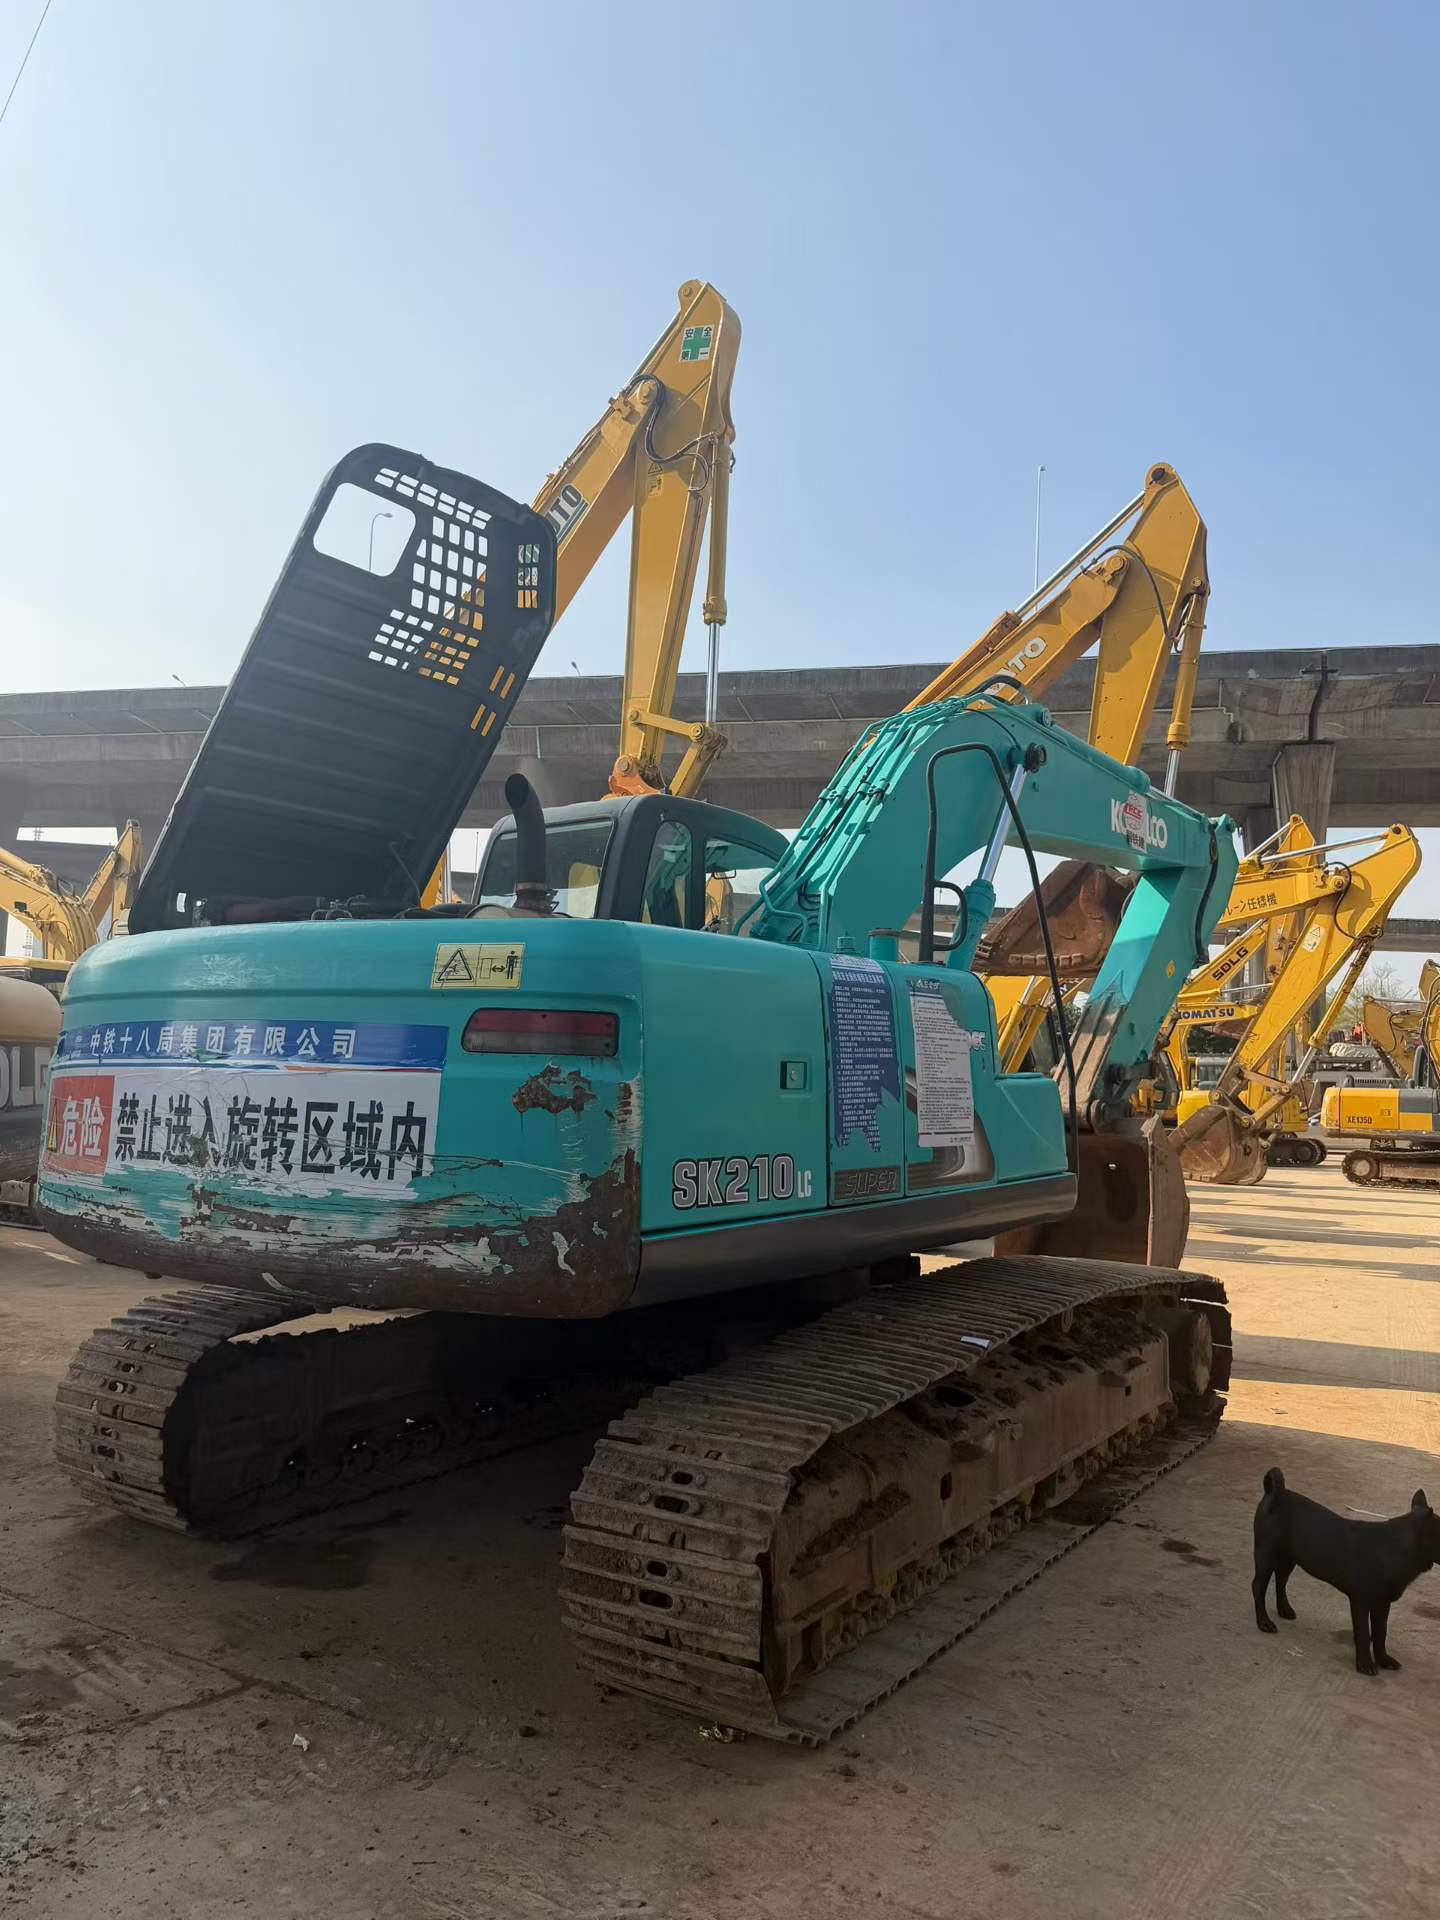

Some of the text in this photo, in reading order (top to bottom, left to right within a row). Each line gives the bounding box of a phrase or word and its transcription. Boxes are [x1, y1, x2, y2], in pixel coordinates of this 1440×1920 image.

[1211, 946, 1249, 981] SDLG
[89, 1025, 357, 1059] 中铁十八局集团有限公司
[60, 1094, 105, 1158] 危险
[114, 1091, 428, 1181] 禁止进入旋转区域内
[672, 1155, 795, 1210] SK210
[845, 1170, 898, 1197] SUPER
